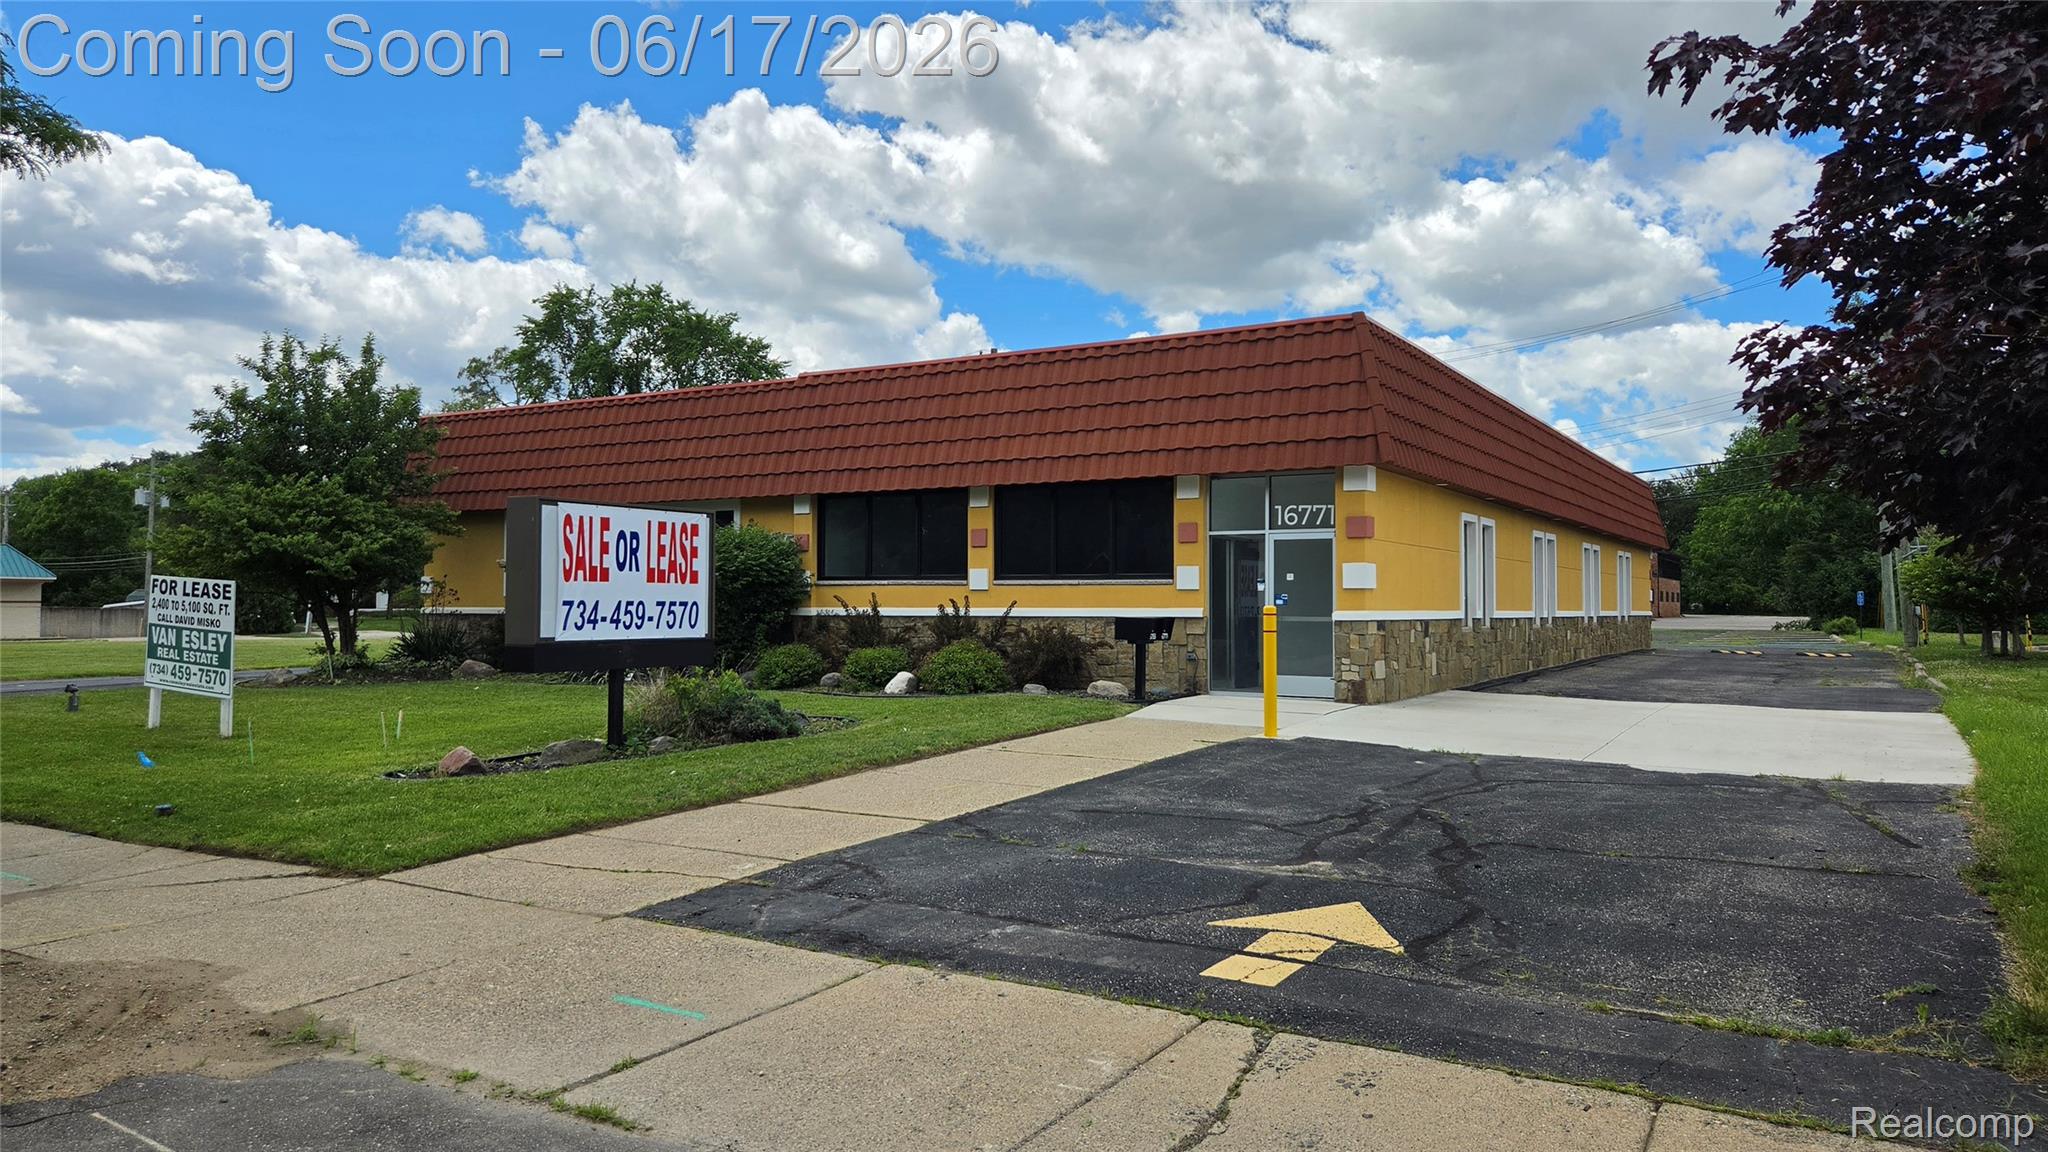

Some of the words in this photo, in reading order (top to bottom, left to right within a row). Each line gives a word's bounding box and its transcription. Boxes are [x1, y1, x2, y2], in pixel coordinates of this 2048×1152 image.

[1274, 504, 1335, 526] 16771
[562, 512, 611, 583] SALE
[615, 529, 641, 572] OR
[646, 519, 700, 585] LEASE
[151, 578, 178, 596] FOR
[182, 580, 232, 601] LEASE
[151, 597, 170, 611] 2,400
[171, 600, 180, 612] TO
[181, 600, 201, 615] 5,100
[203, 602, 217, 615] SQ.
[219, 603, 231, 616] FT.
[561, 600, 700, 632] 734-459-7570
[157, 613, 173, 624] CALL
[175, 614, 196, 627] DAVID
[197, 617, 221, 629] MISKO
[151, 625, 177, 647] VAN
[182, 629, 228, 653] ESLEY
[157, 646, 180, 660] REAL
[183, 650, 219, 666] ESTATE
[149, 662, 169, 676] (734)
[170, 663, 227, 687] 459-7570
